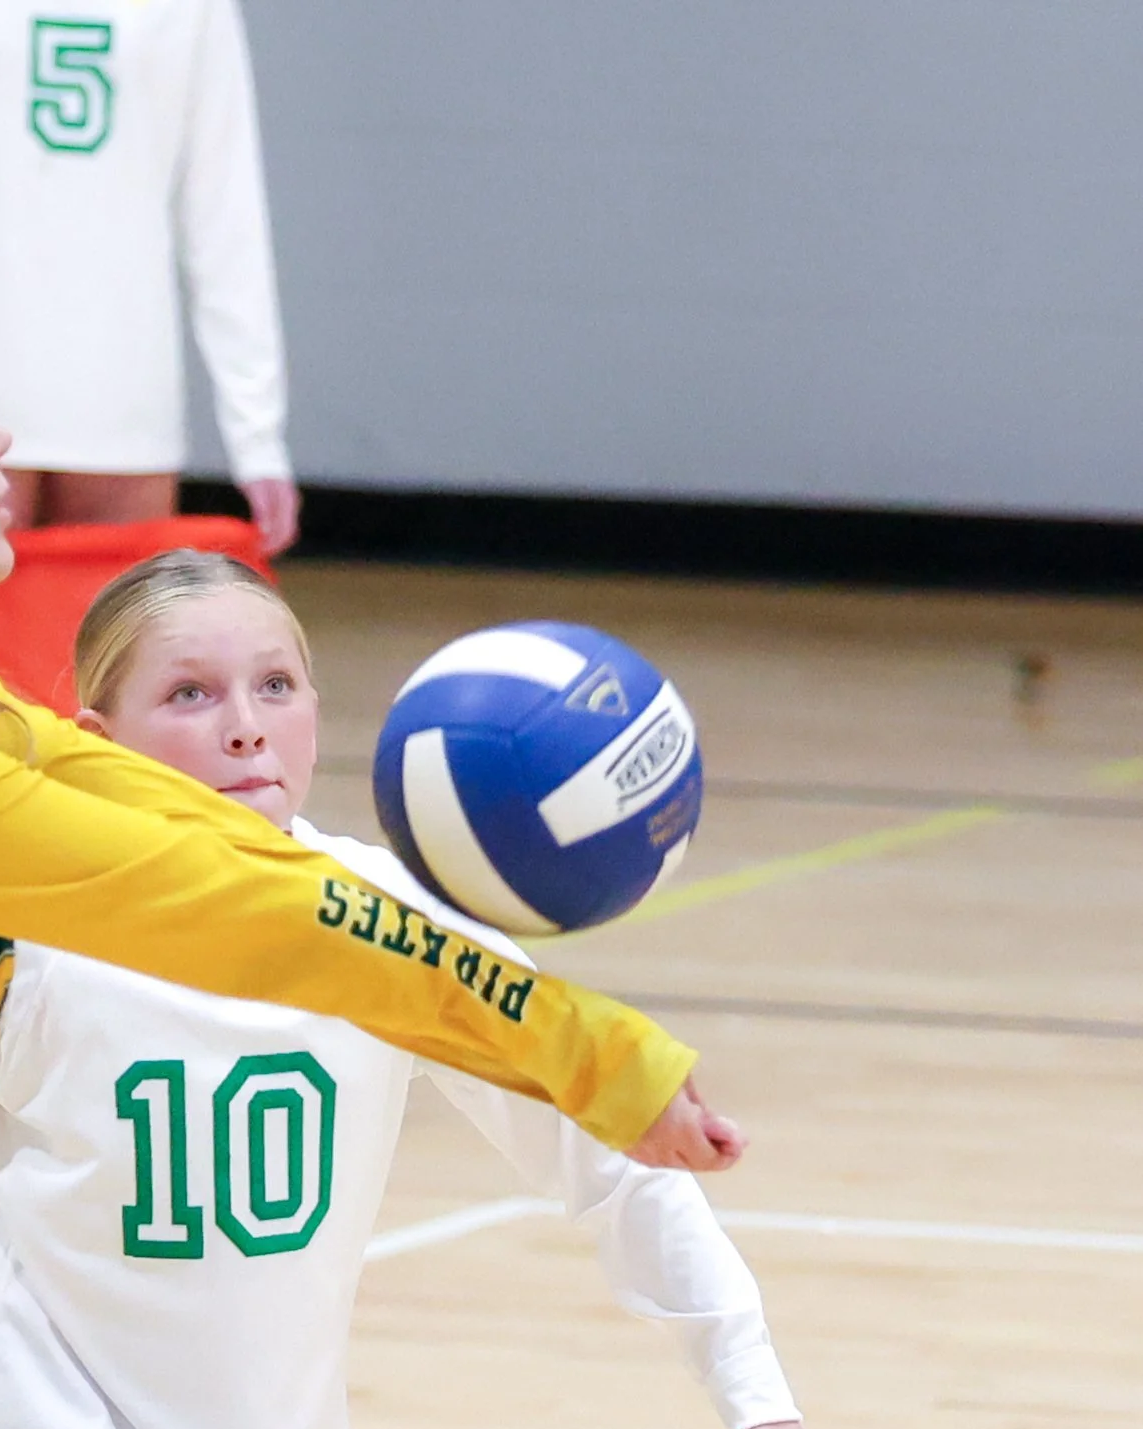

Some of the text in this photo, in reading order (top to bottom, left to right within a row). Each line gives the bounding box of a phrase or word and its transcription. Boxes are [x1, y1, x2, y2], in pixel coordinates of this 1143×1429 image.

[32, 19, 113, 154] 5
[317, 878, 535, 1023] PIRATES
[115, 1051, 337, 1260] 10
